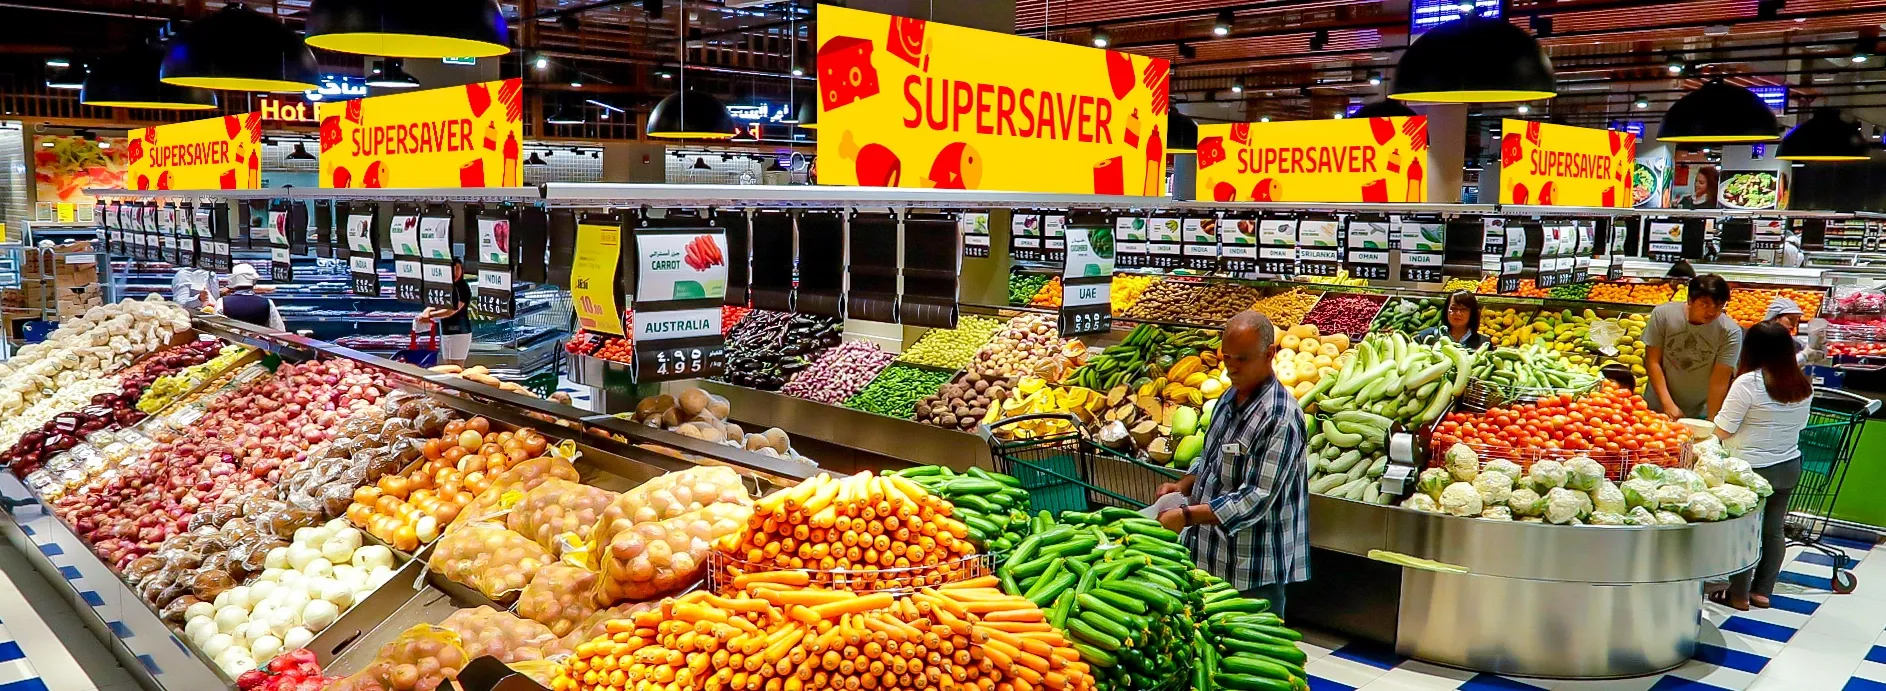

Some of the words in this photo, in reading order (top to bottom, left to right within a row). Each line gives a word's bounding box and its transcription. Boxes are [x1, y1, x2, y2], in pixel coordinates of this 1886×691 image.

[261, 99, 306, 121] Hot
[903, 74, 1113, 145] SUPERSAVER
[352, 118, 475, 157] SUPERSAVER
[150, 140, 230, 168] SUPERSAVER
[1237, 145, 1377, 174] SUPERSAVER
[1530, 148, 1611, 180] SUPERSAVER
[403, 264, 414, 274] USA
[431, 268, 443, 278] USA
[651, 260, 681, 271] CARROT
[485, 273, 502, 285] INDIA
[1080, 287, 1097, 299] UAE
[645, 319, 710, 334] AUSTRALIA
